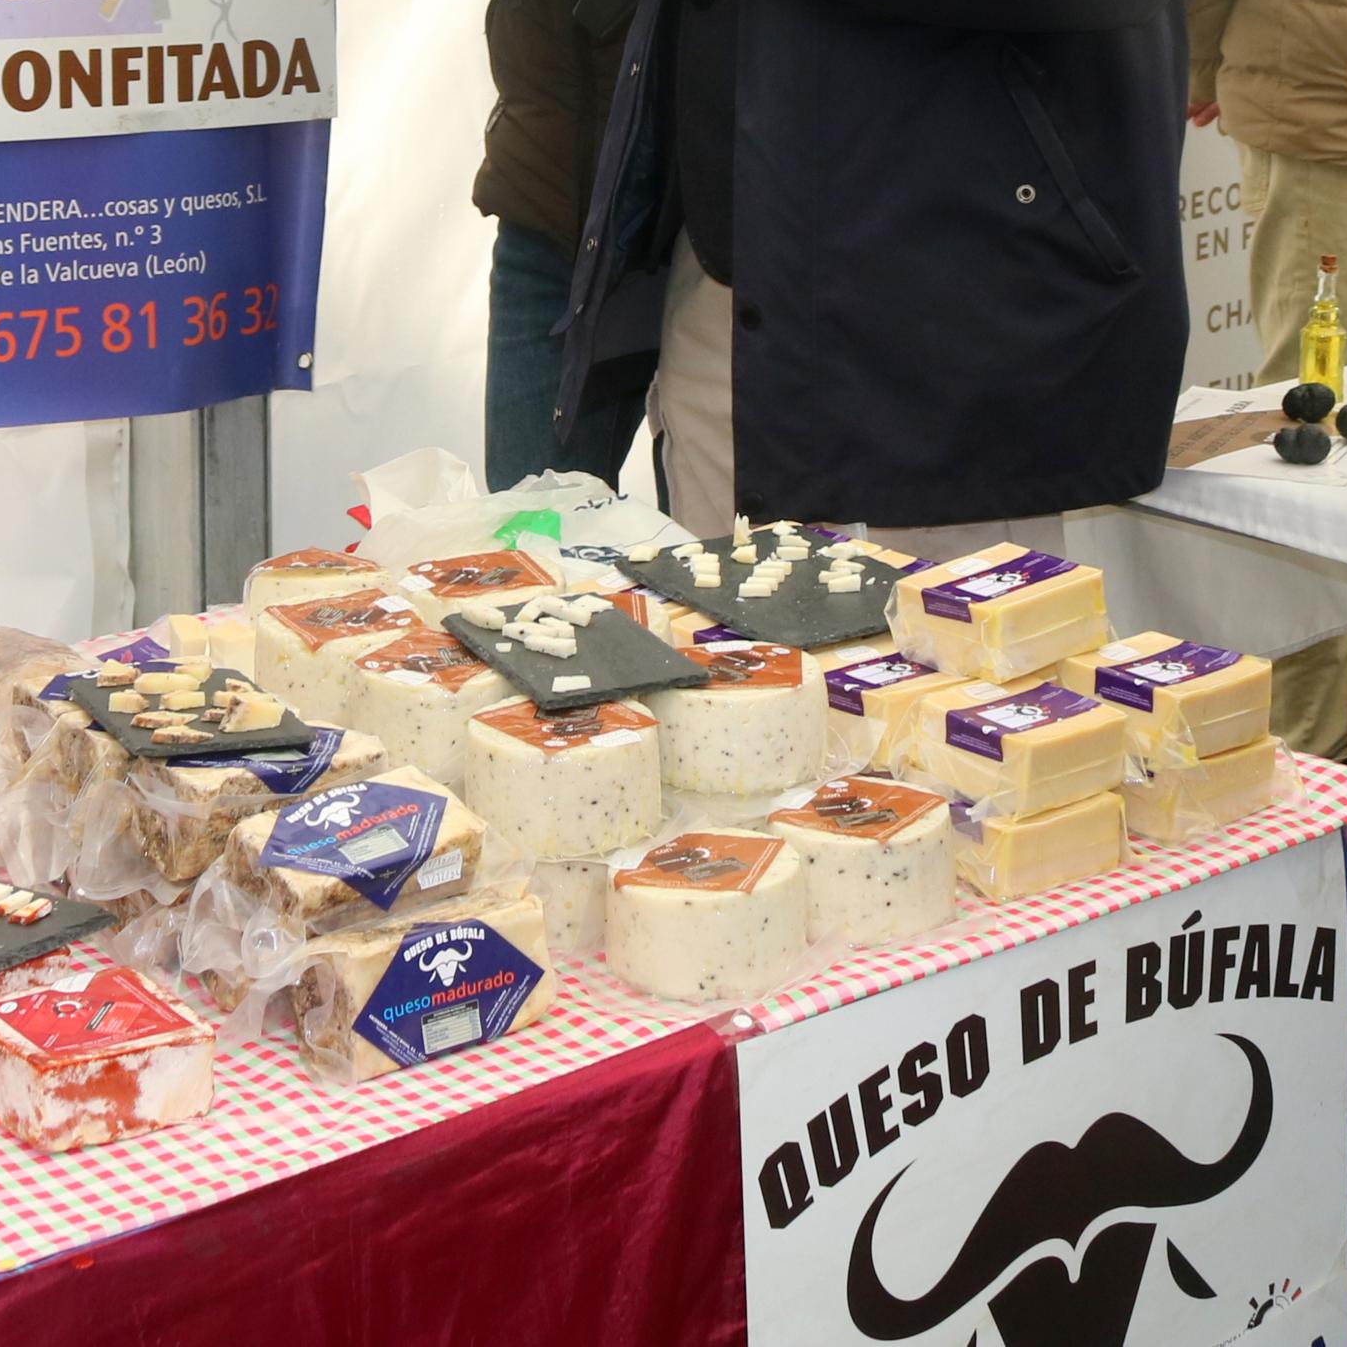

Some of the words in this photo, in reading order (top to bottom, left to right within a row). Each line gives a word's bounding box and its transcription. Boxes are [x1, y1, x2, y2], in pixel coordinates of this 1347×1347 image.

[163, 198, 176, 219] y
[180, 189, 243, 216] quesos,
[20, 231, 108, 254] Fuentes,
[149, 224, 163, 245] 3
[1195, 227, 1229, 262] EN
[20, 264, 40, 286] la
[45, 260, 139, 283] Valcueva
[145, 250, 207, 279] (León)
[101, 300, 158, 354] 81
[182, 290, 229, 347] 36
[239, 283, 280, 336] 32
[403, 935, 434, 962] QUESO
[435, 931, 449, 945] DE
[450, 925, 486, 941] BÚFALA
[383, 970, 516, 1023] quesomadurado
[757, 1013, 991, 1230] QUESO
[1019, 960, 1098, 1065] DE
[1125, 909, 1338, 1024] BÚFALA
